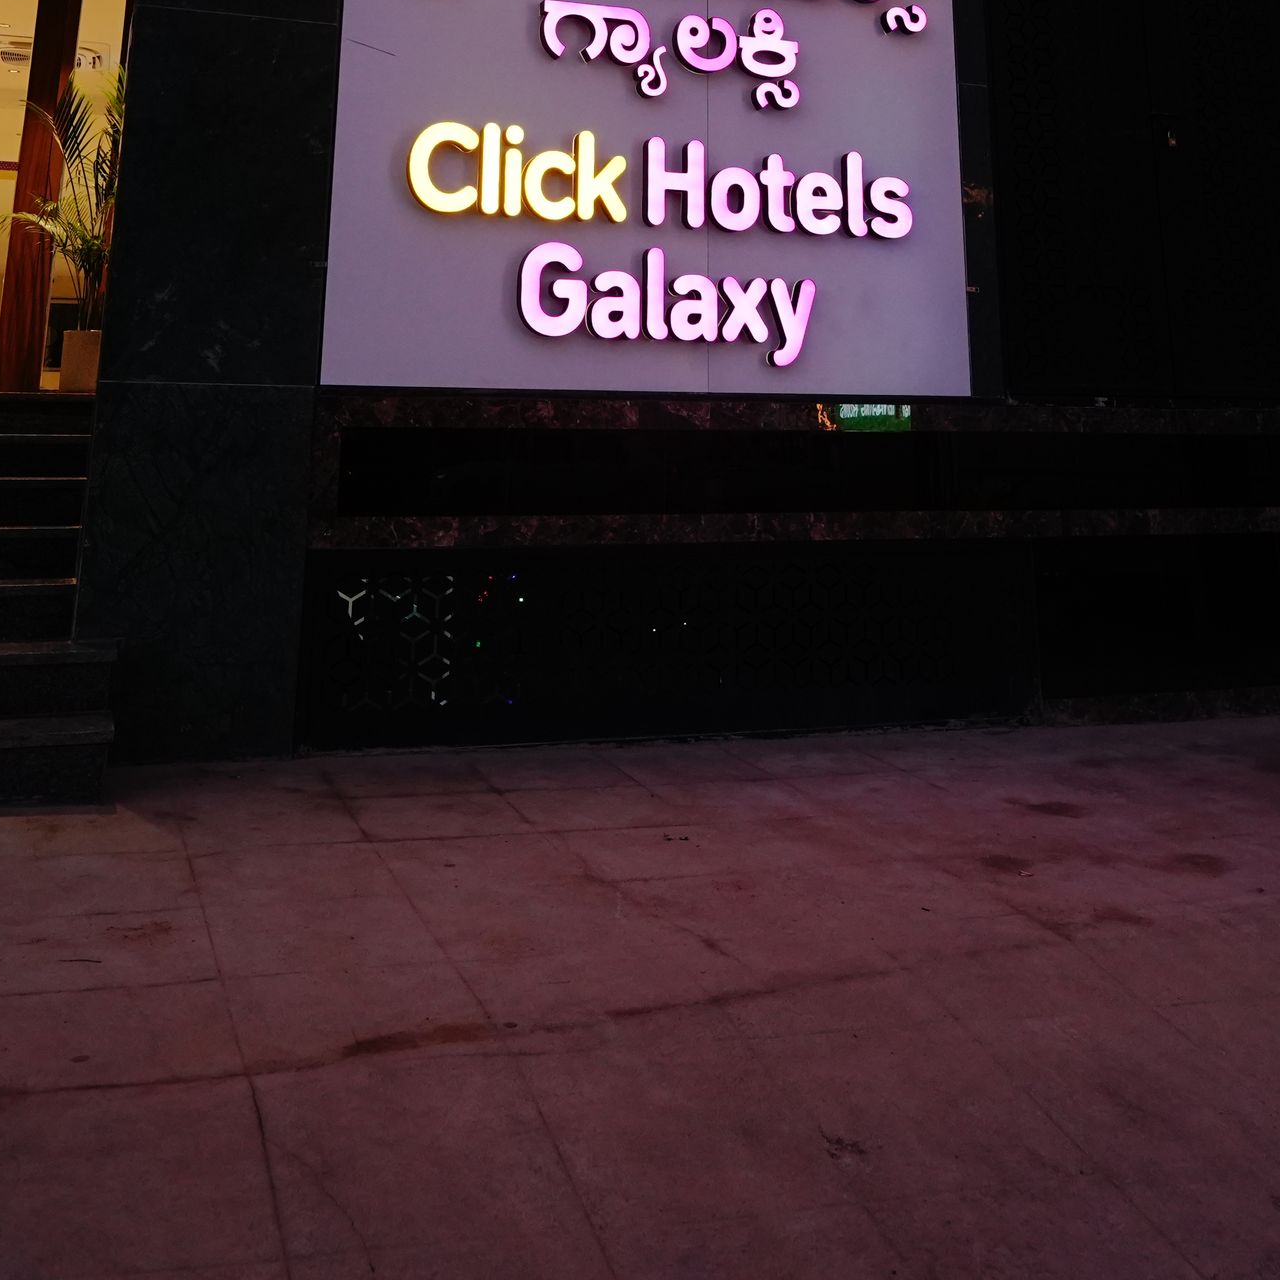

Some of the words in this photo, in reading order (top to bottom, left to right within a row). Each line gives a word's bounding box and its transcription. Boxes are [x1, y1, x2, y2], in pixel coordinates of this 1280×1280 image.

[408, 122, 627, 222] Click
[646, 137, 913, 240] Hotels
[520, 242, 816, 368] Galaxy
